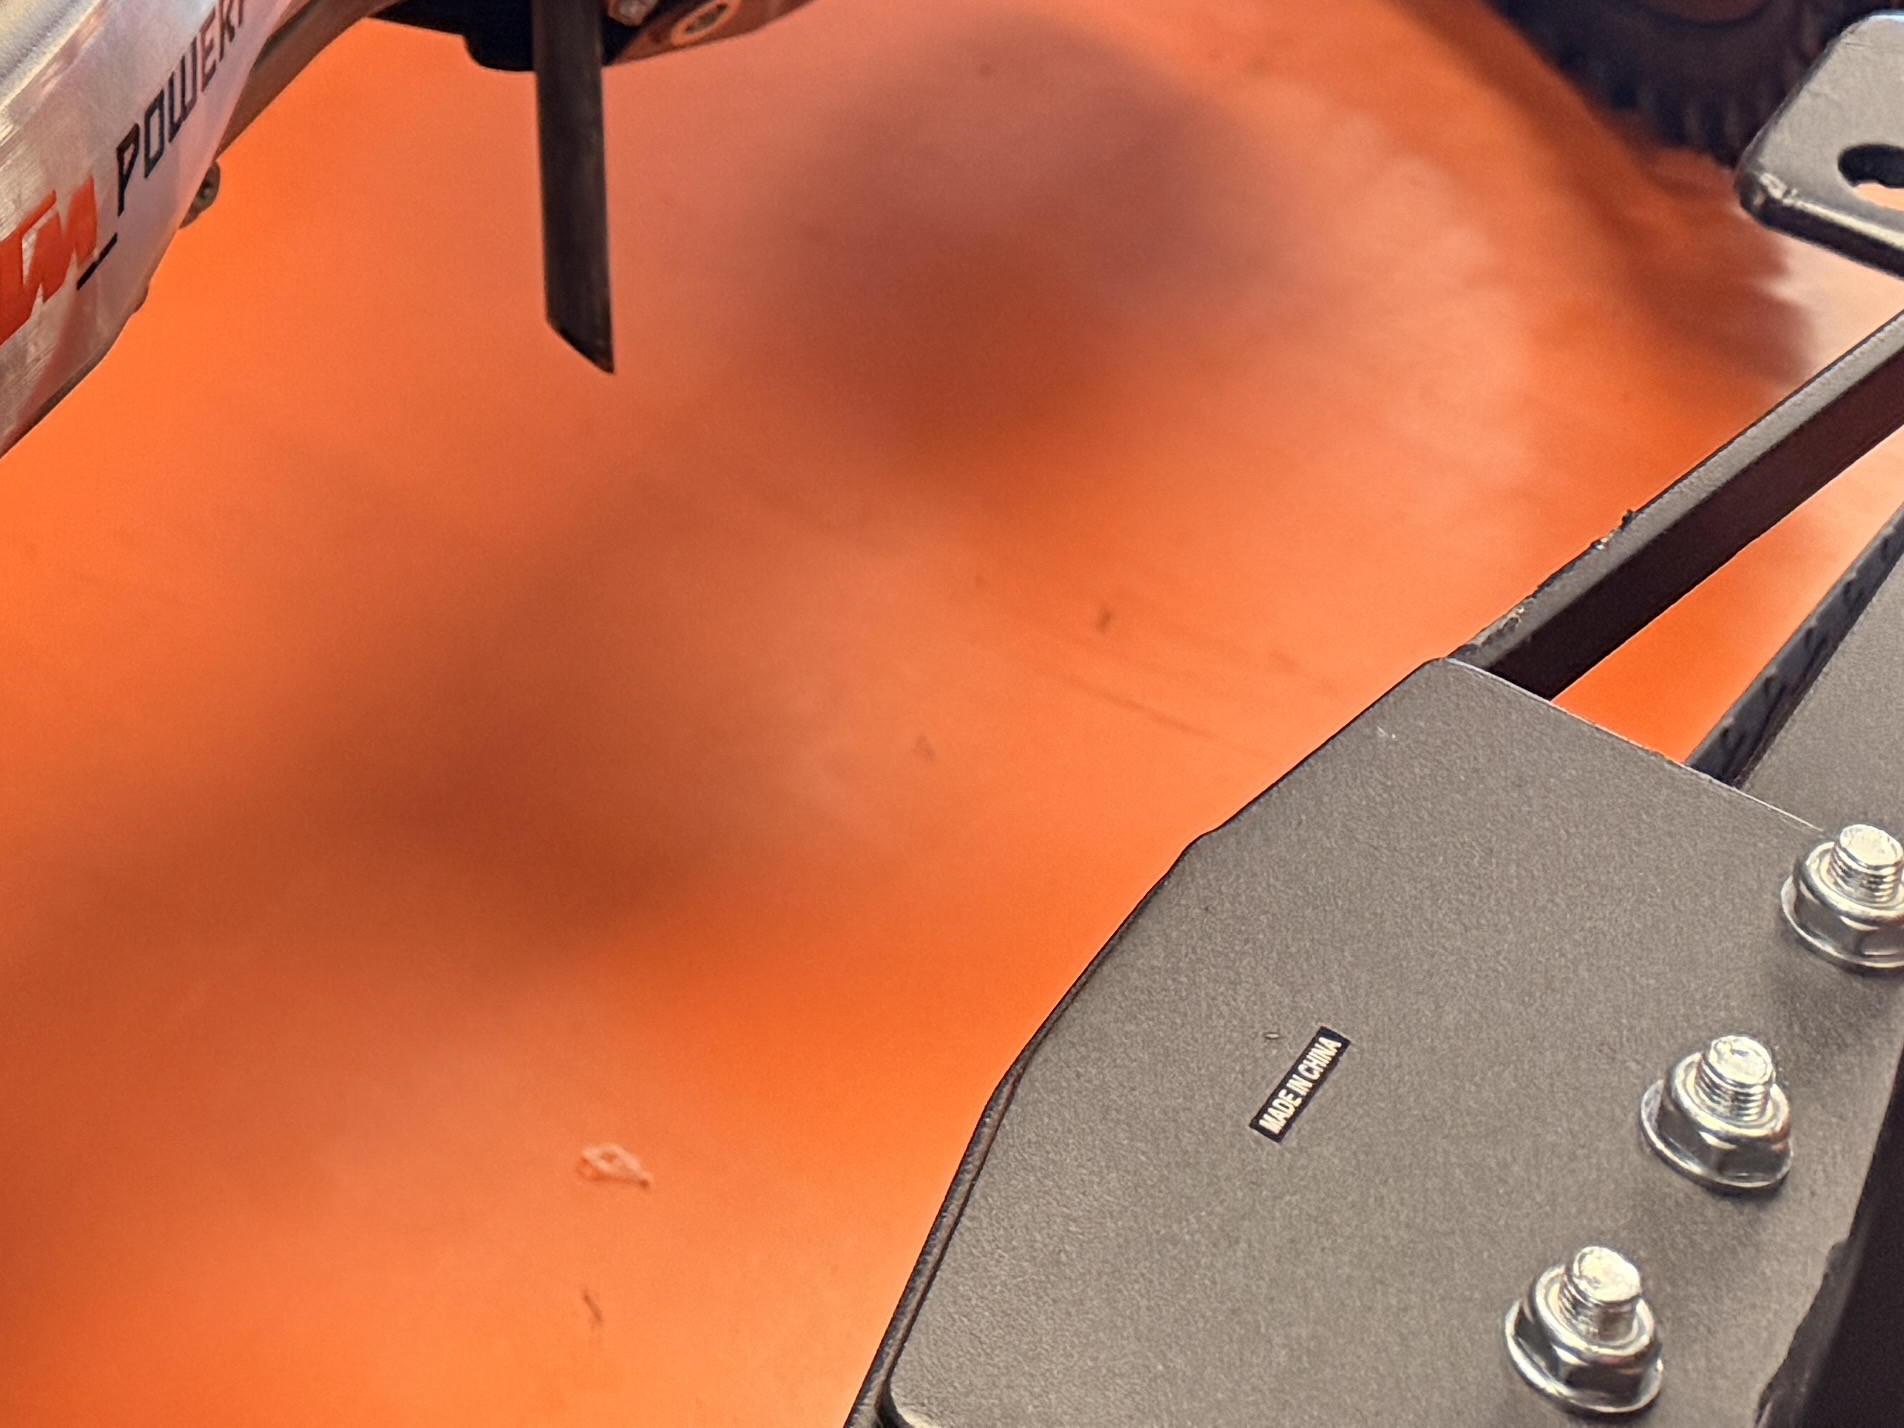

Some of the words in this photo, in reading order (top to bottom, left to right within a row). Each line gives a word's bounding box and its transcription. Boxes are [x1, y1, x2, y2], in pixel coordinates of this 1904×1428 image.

[1298, 1036, 1342, 1081] CHINA
[1286, 1073, 1313, 1097] IN
[1259, 1088, 1303, 1134] MADE
